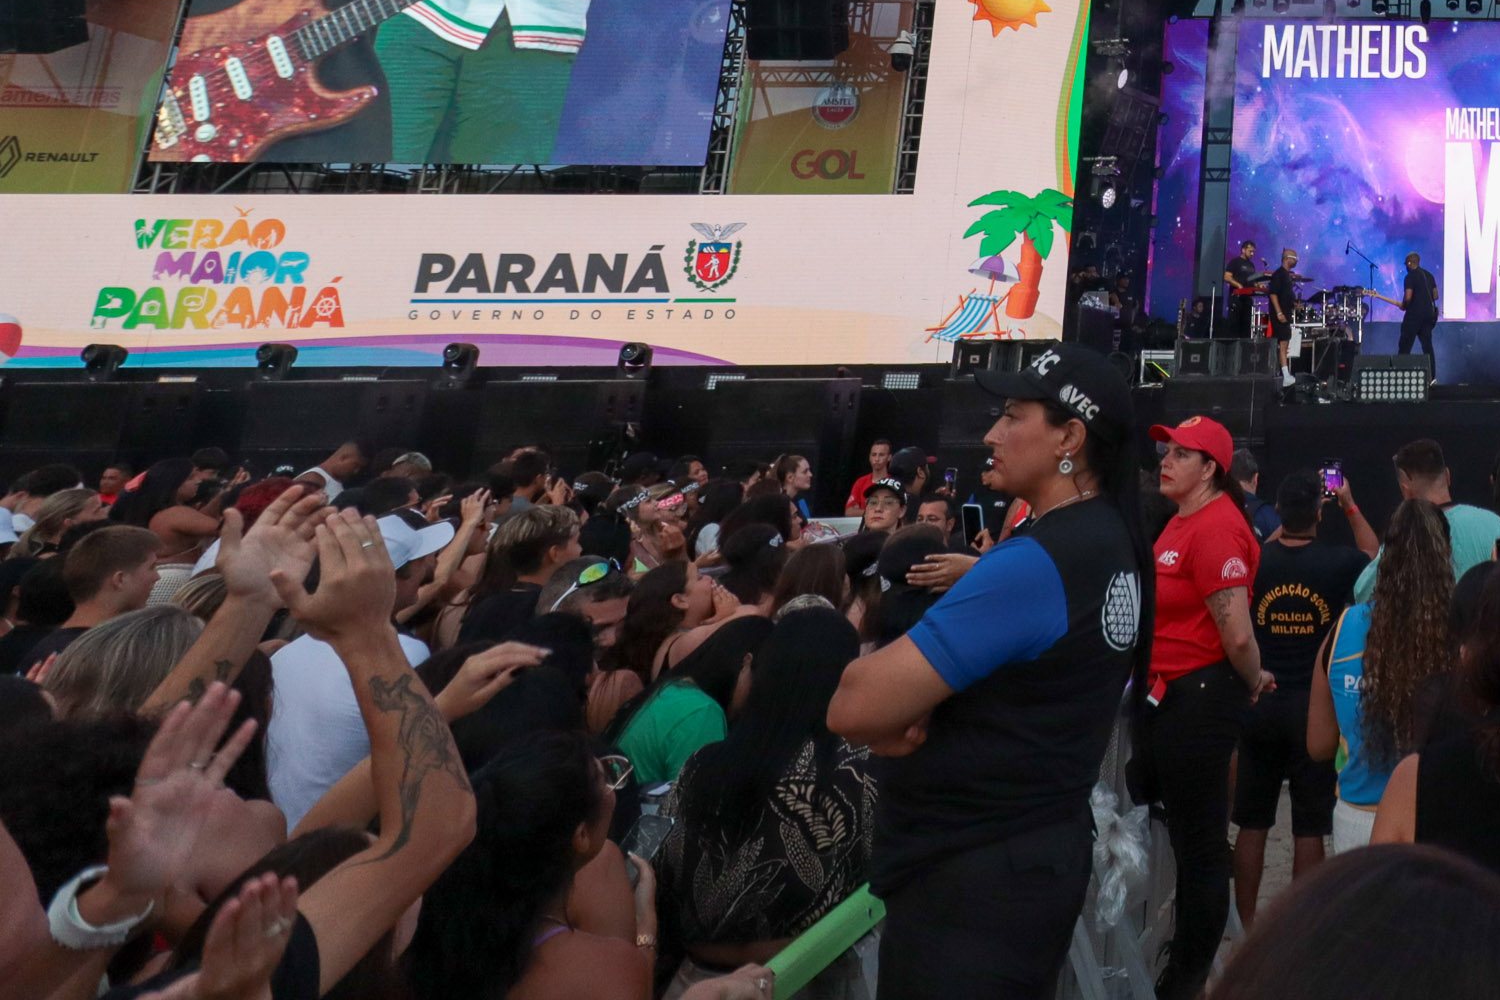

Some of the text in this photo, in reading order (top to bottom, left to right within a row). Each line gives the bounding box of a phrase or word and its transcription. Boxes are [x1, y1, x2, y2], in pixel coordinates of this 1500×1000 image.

[1262, 24, 1427, 79] MATHEUS
[24, 152, 99, 162] RENAULT
[791, 149, 866, 180] GOL
[133, 206, 286, 249] VERÃO
[153, 251, 310, 284] MAIOR
[414, 244, 670, 293] PARANÁ
[90, 276, 345, 330] PARANÁ
[408, 309, 737, 321] GOVERNO DO ESTADO
[1257, 583, 1331, 626] COMUNICAÇÃO SOCIAL
[1270, 612, 1313, 622] POLÍCIA
[1271, 625, 1315, 634] MILITAR
